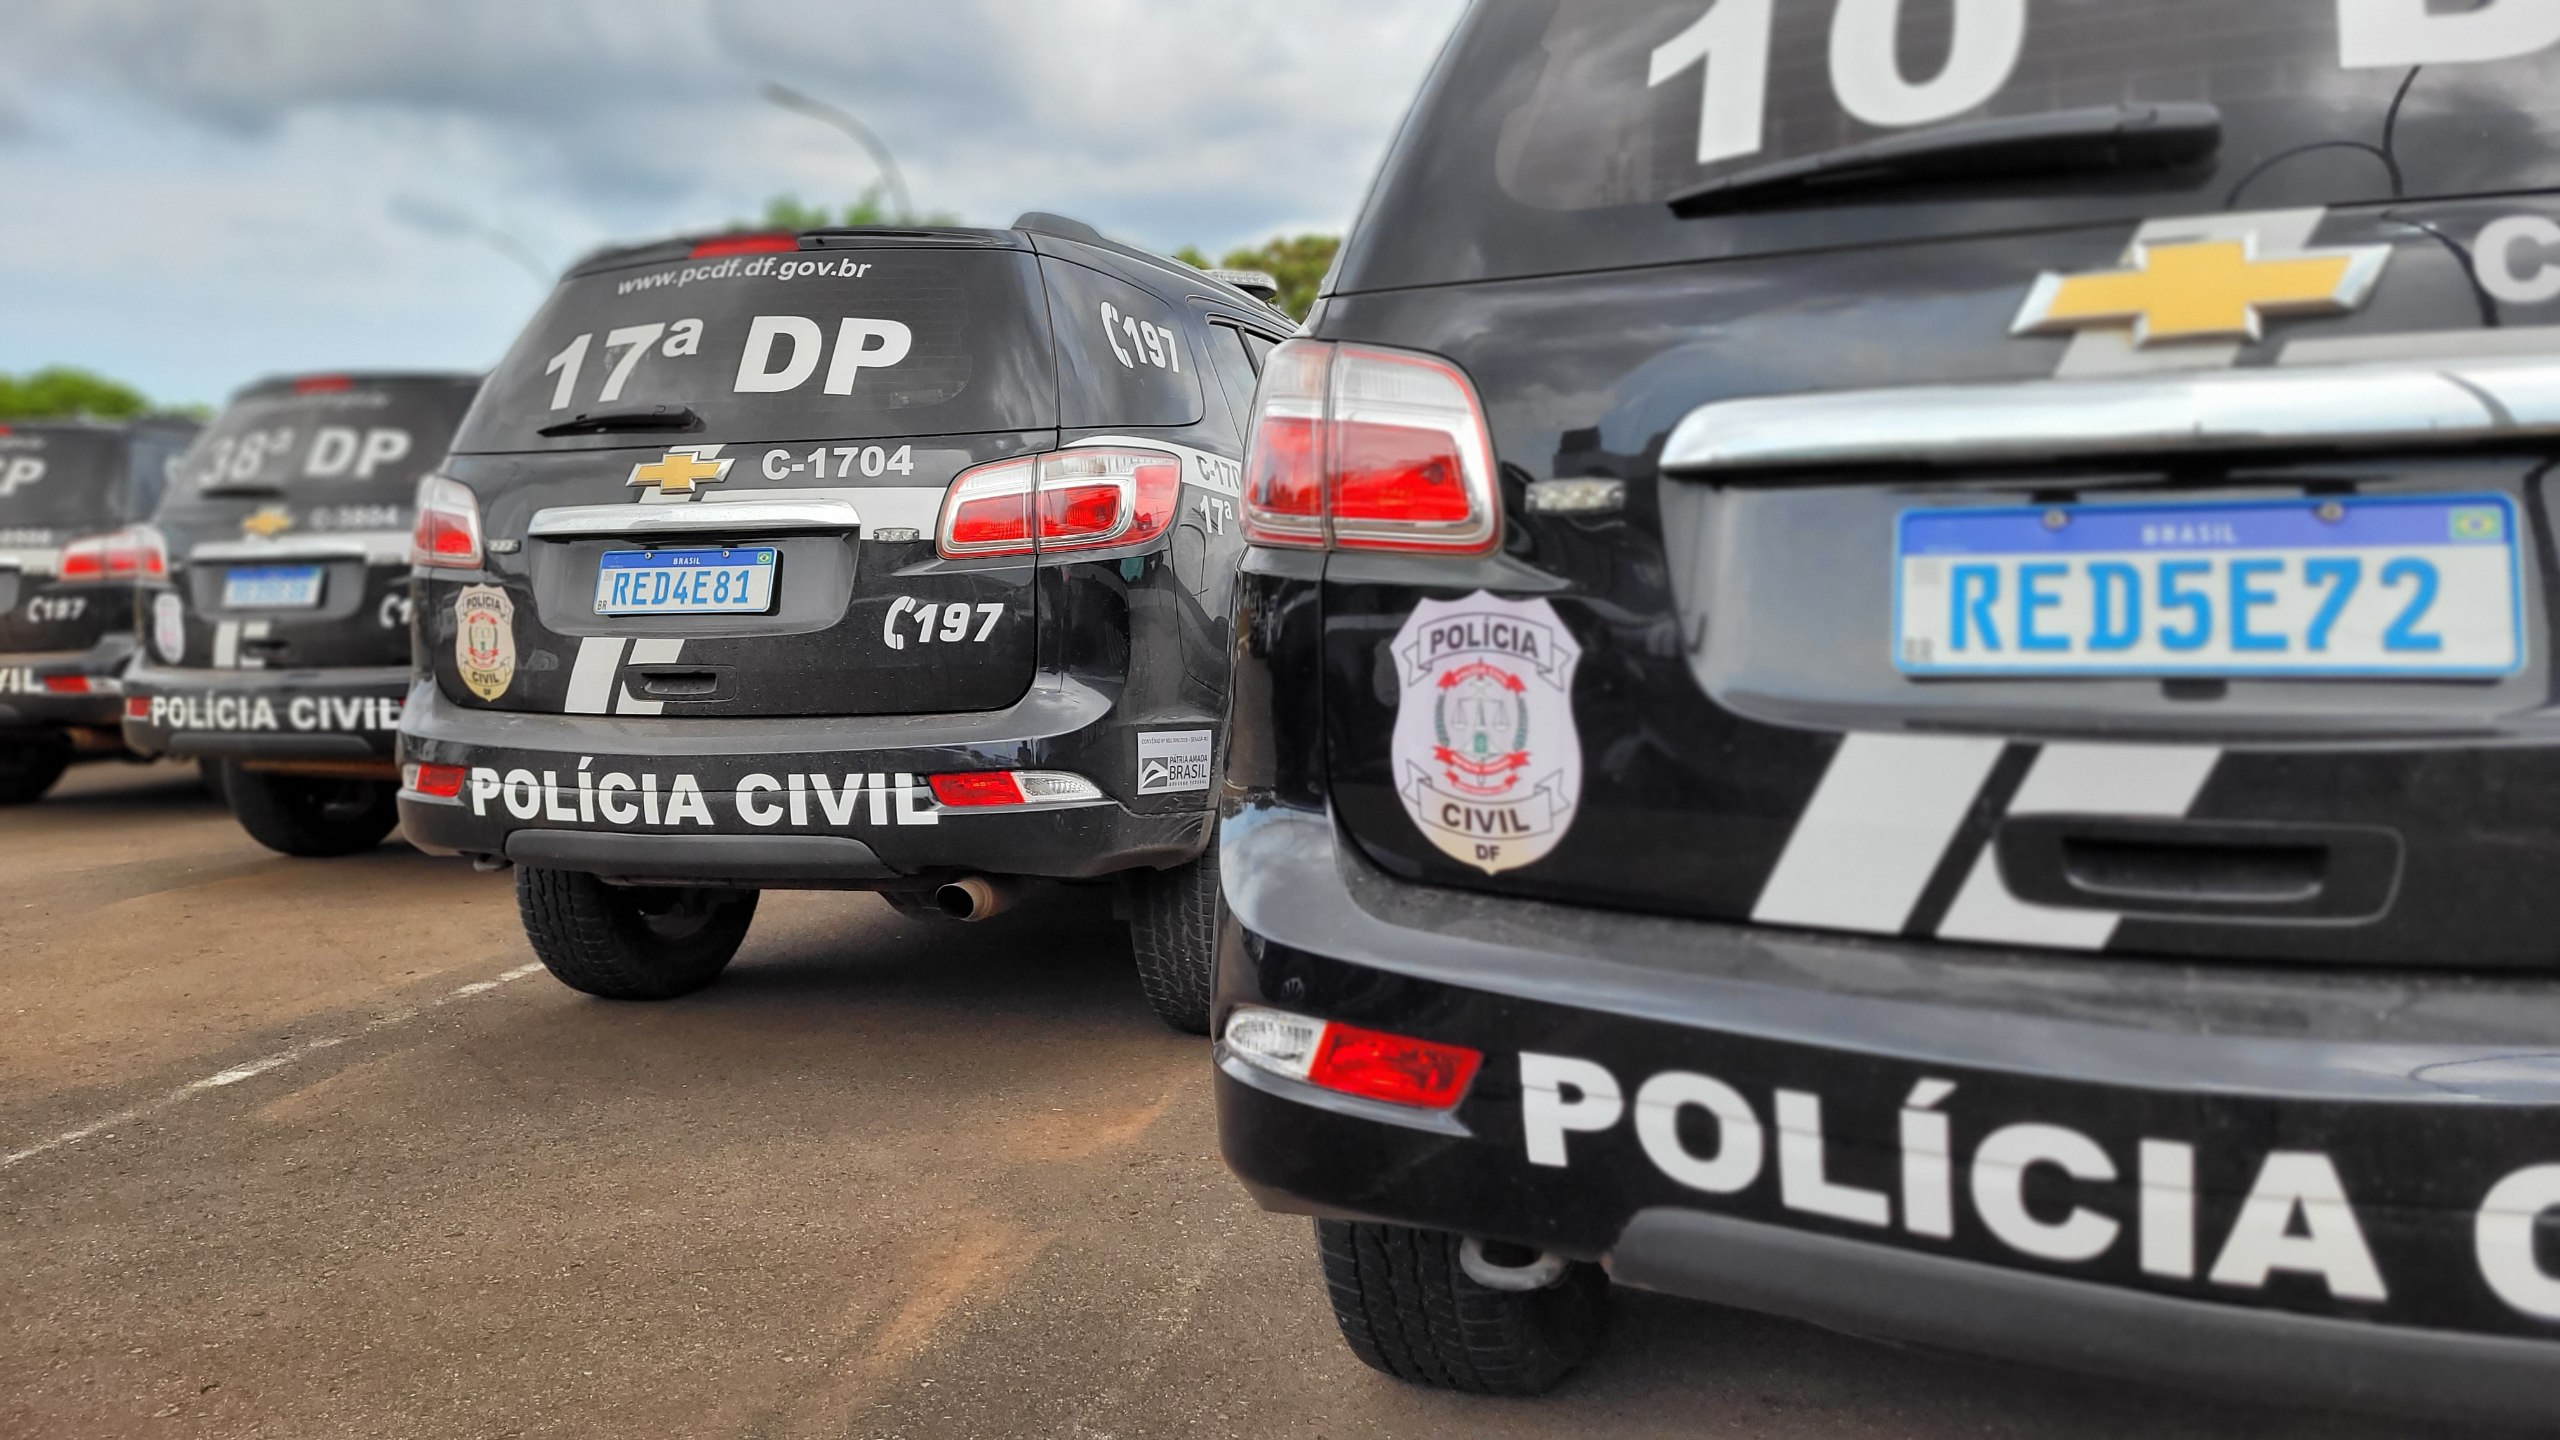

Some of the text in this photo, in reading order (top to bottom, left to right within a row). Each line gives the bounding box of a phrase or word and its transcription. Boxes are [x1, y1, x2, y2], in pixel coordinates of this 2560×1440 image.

[617, 257, 872, 295] www.pcdf.df.gov.br
[733, 315, 912, 396] DP
[304, 426, 412, 478] DP
[761, 445, 914, 482] C-1704
[673, 556, 701, 565] BRASIL
[611, 569, 750, 607] RED4E81
[1949, 556, 2443, 653] RED5E72
[913, 602, 1004, 642] 197
[1430, 616, 1539, 659] POLÍCIA
[472, 671, 500, 684] CIVIL
[152, 690, 400, 731] POLÍCIA CIVIL
[1169, 764, 1207, 780] BRASIL
[1189, 754, 1207, 763] AMADA
[470, 757, 940, 826] POLÍCIA CIVIL
[1441, 803, 1531, 834] CIVIL
[1475, 844, 1501, 862] DF
[1518, 1051, 2389, 1302] POLÍCIA
